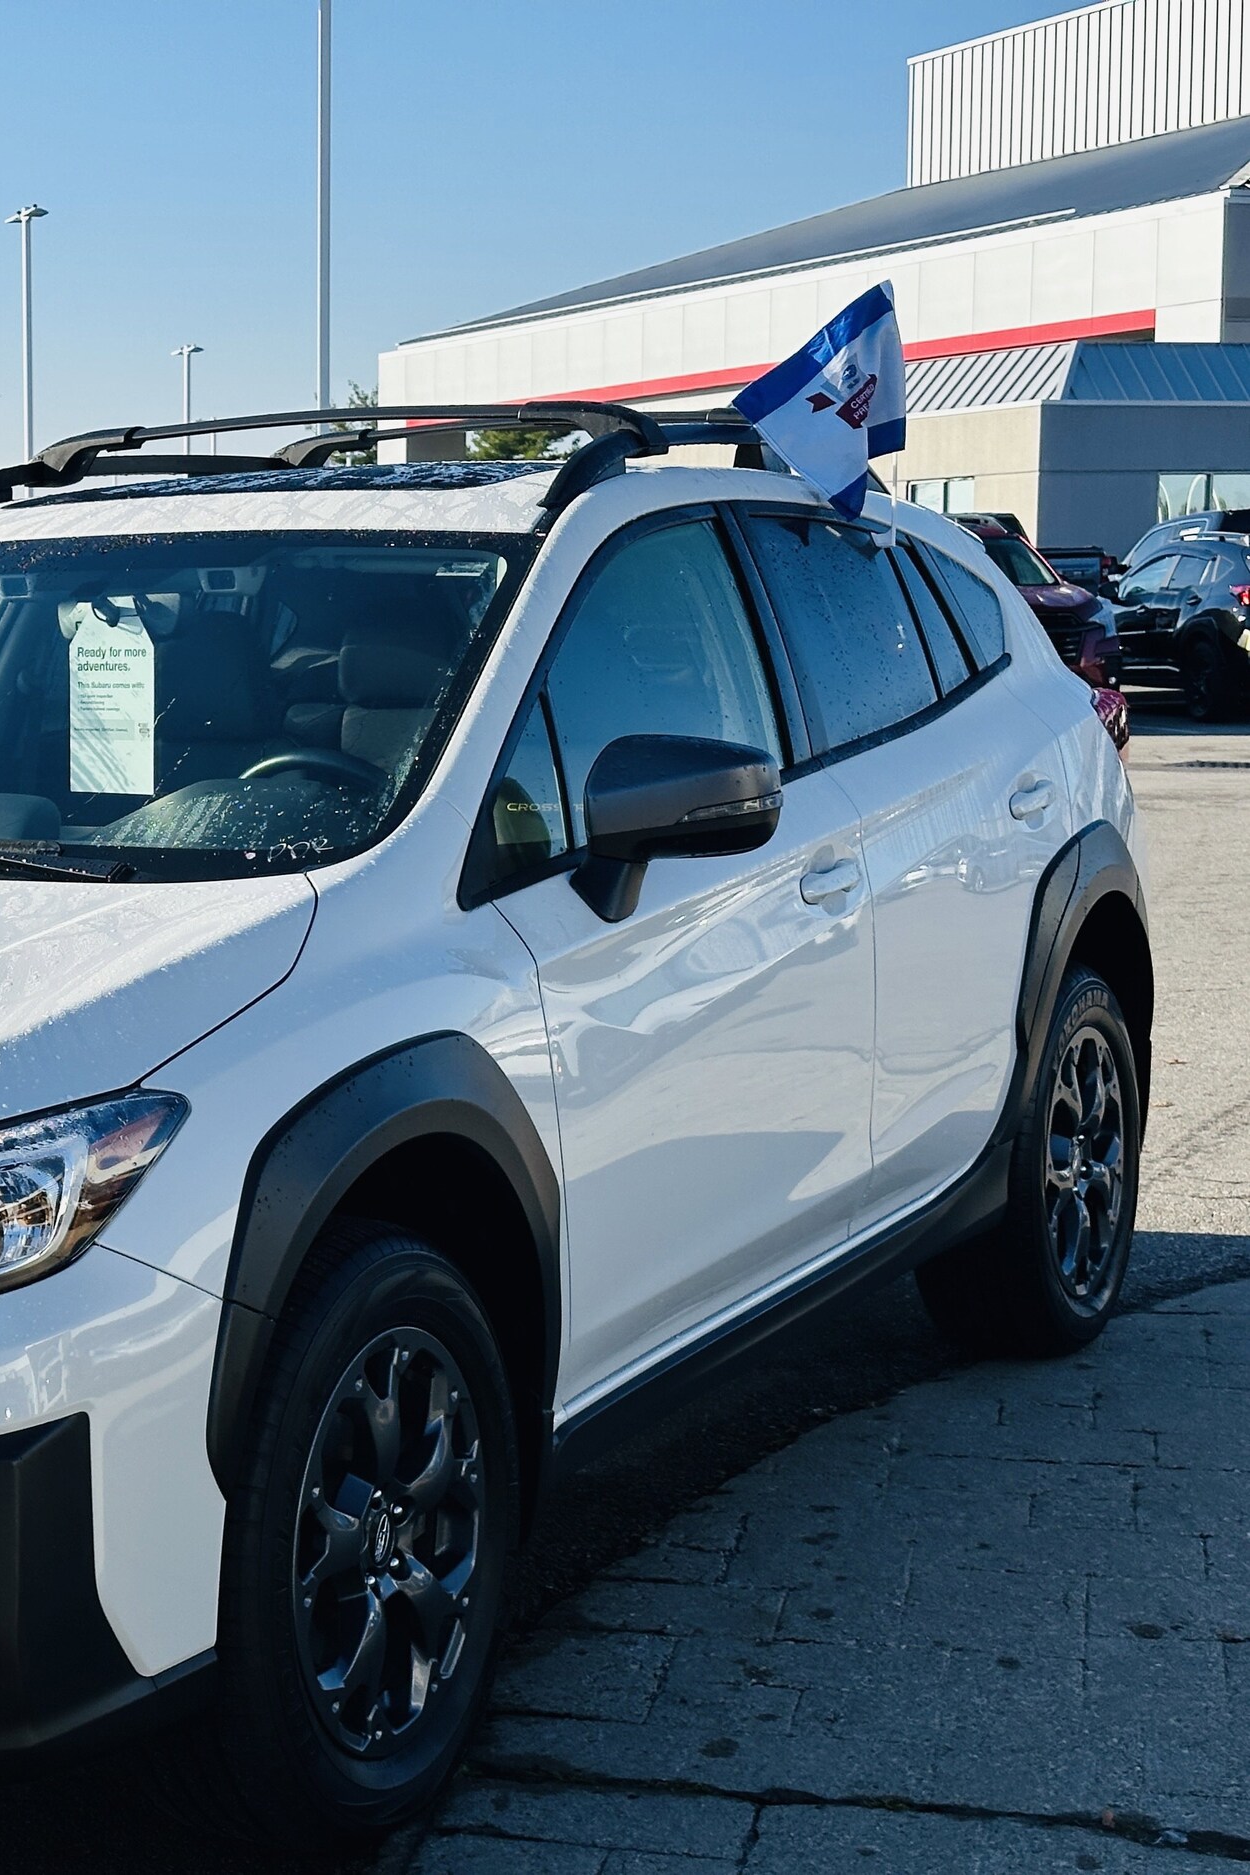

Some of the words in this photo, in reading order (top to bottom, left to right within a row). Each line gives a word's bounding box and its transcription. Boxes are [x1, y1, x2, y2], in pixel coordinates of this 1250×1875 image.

[77, 646, 106, 660] Ready
[109, 646, 122, 657] for
[124, 648, 147, 657] more
[77, 660, 131, 671] adventures.
[78, 681, 89, 689] This
[91, 681, 111, 689] Subaru
